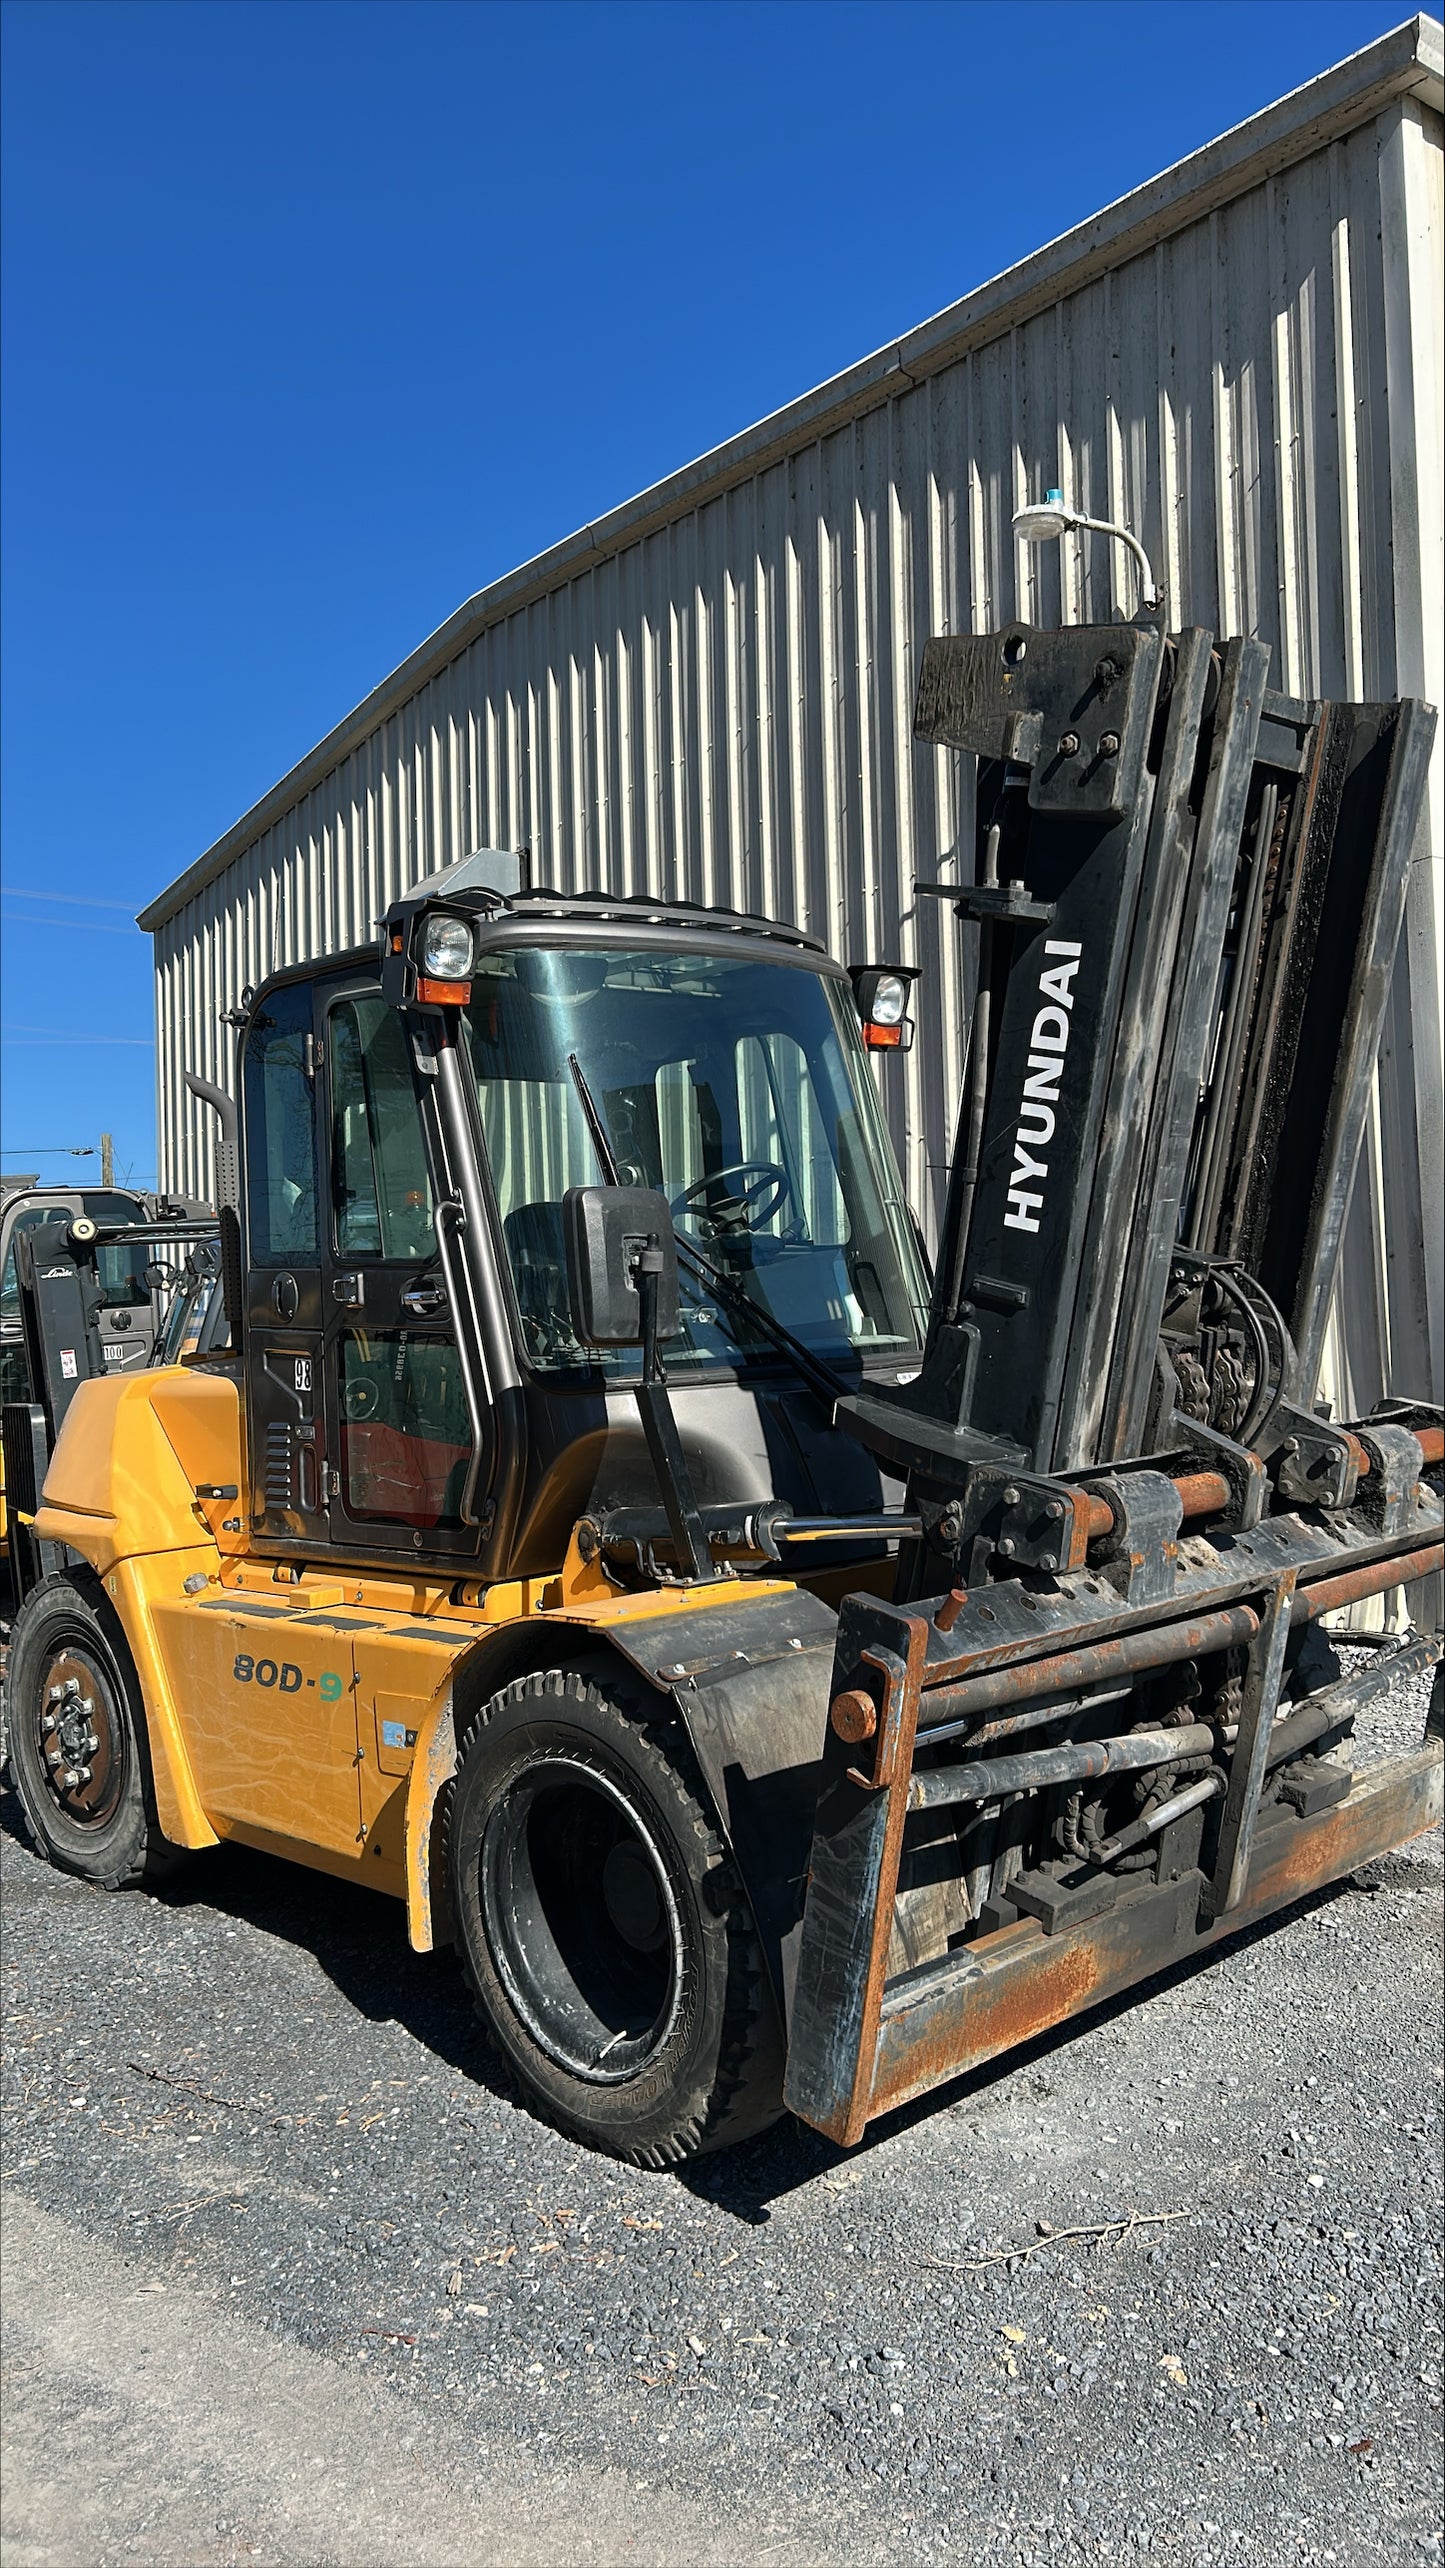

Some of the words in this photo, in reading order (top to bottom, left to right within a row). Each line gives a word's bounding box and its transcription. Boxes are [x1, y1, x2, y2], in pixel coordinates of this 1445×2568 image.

[1003, 940, 1083, 1233] HYUNDAI
[41, 1267, 73, 1279] Linde
[296, 1360, 311, 1389] 98
[233, 1654, 342, 1702] 80D-9
